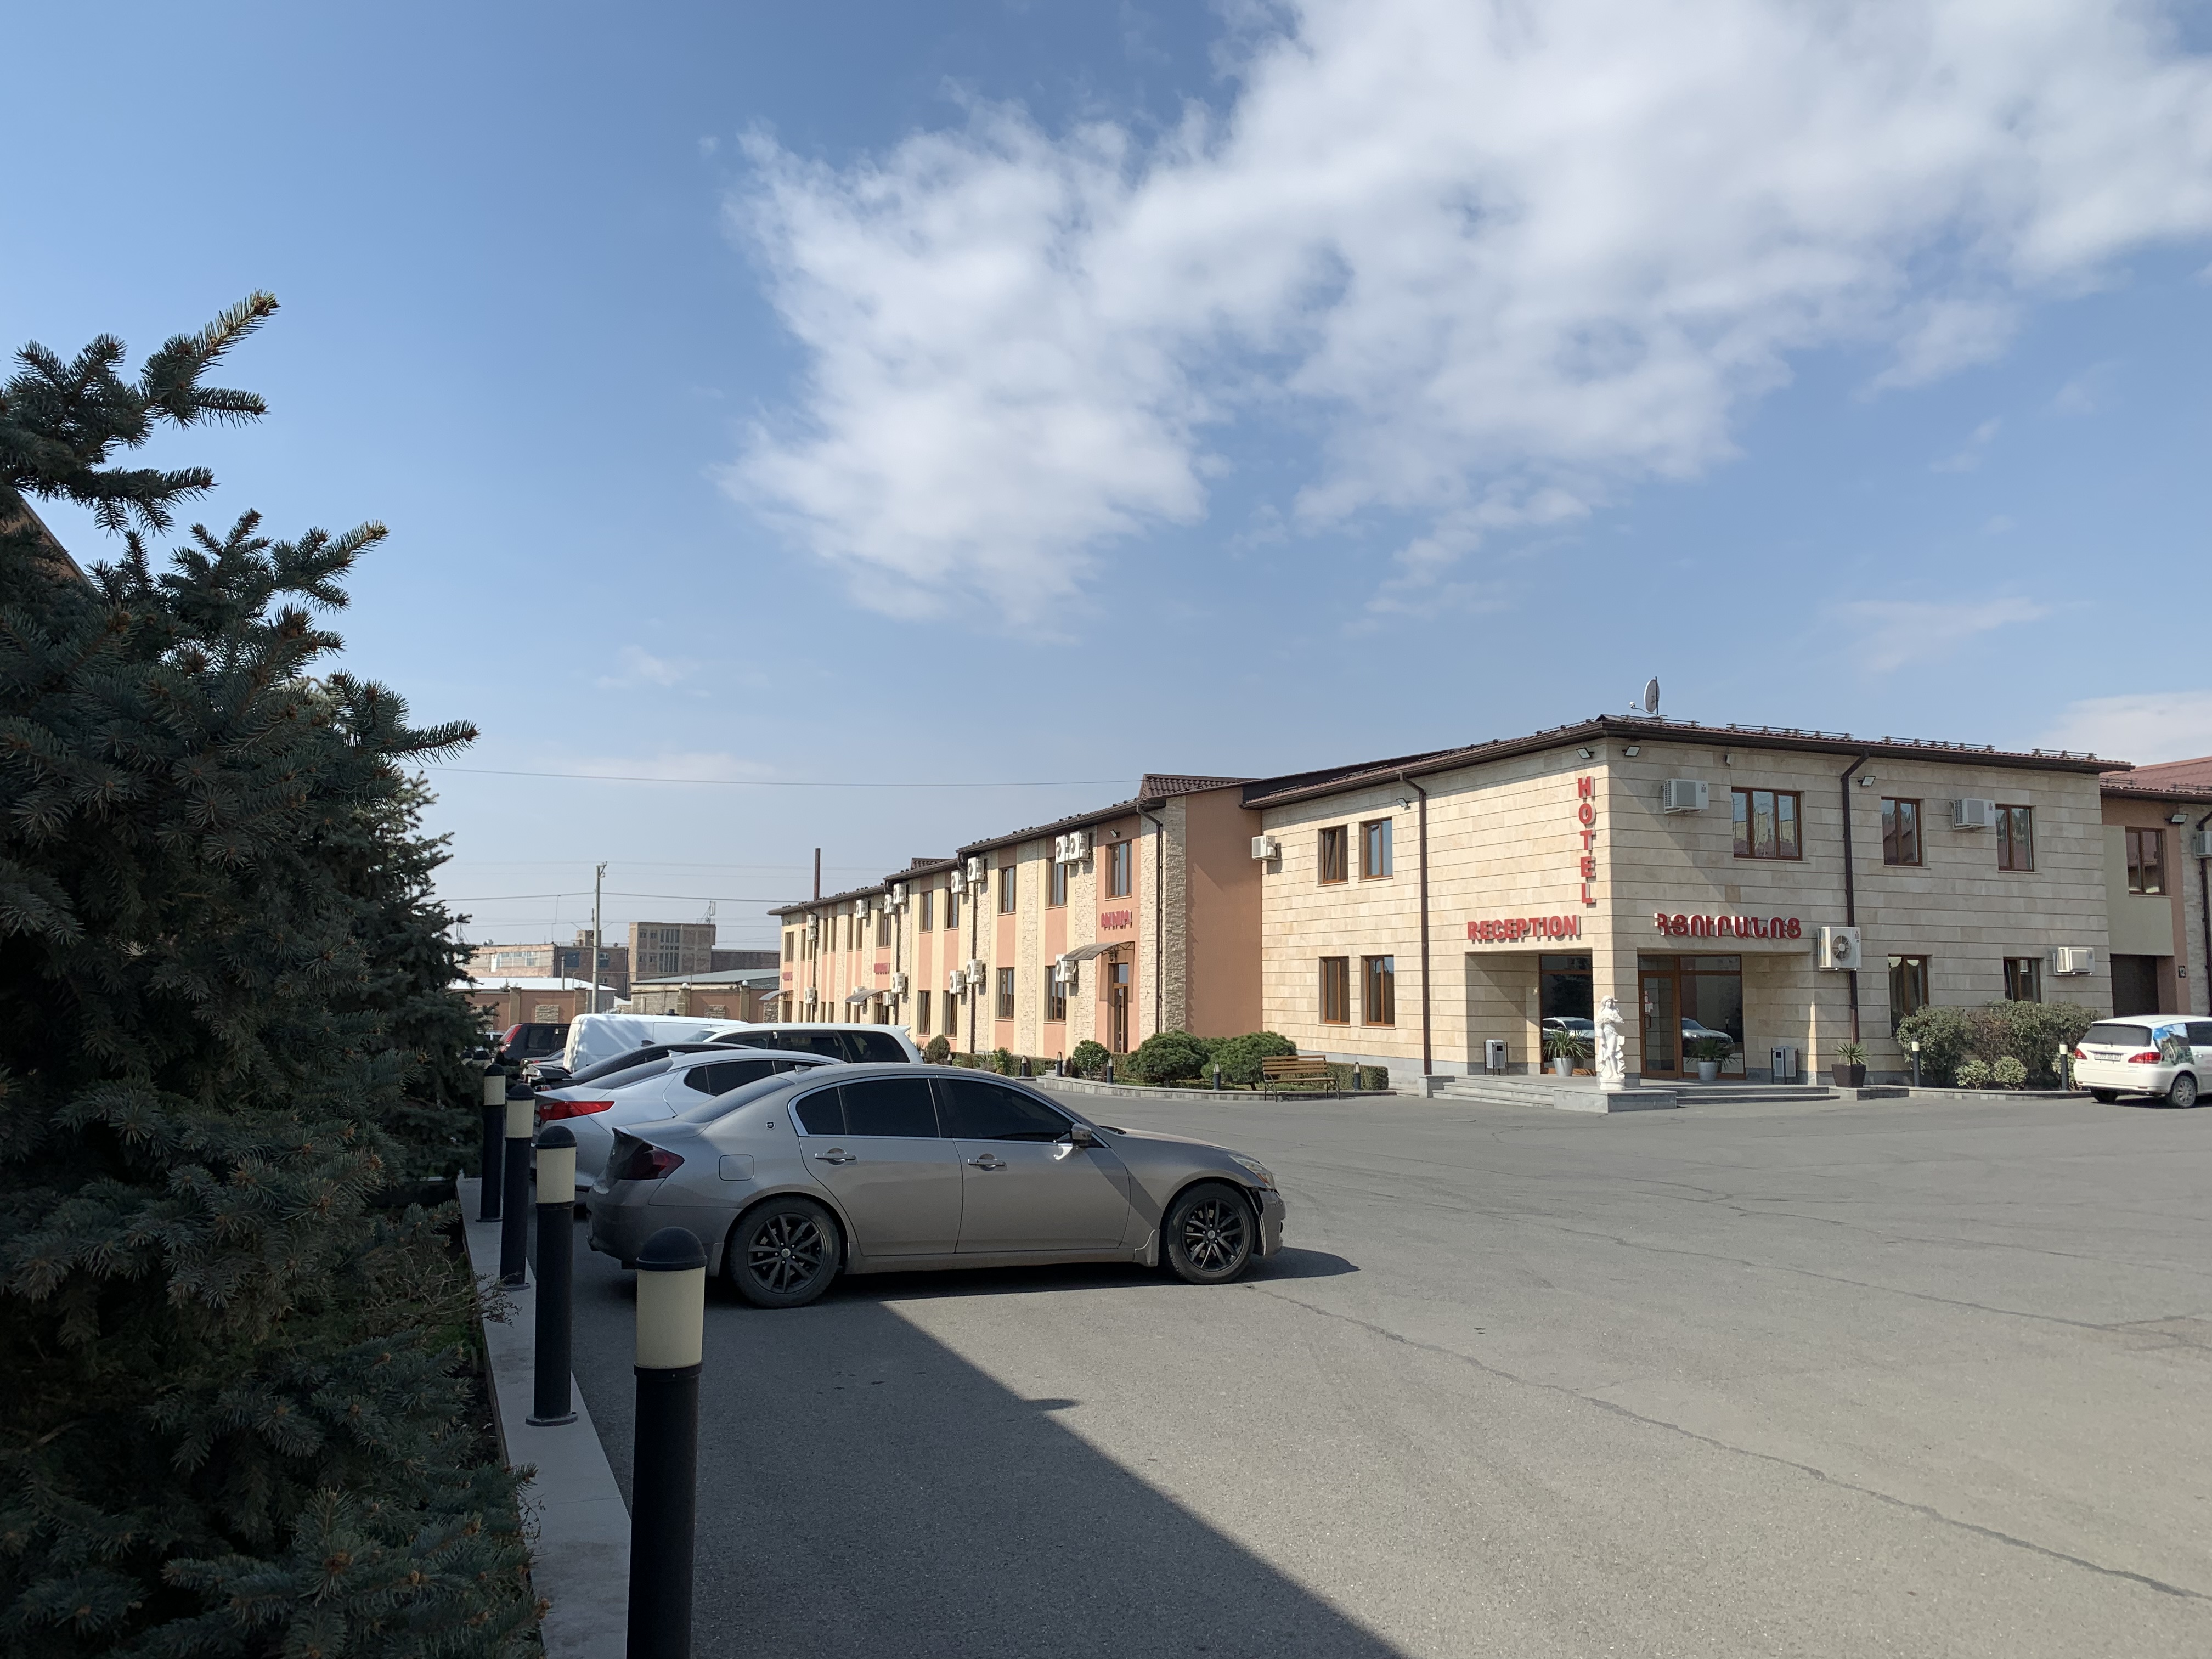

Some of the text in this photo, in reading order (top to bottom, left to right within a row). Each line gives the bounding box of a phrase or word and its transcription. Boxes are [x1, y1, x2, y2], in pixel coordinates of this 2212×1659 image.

[1578, 776, 1596, 904] HOTEL
[1468, 915, 1581, 940] RECEPTION
[1654, 913, 1802, 939] ՀՅՈՒՐԱՆՈՑ
